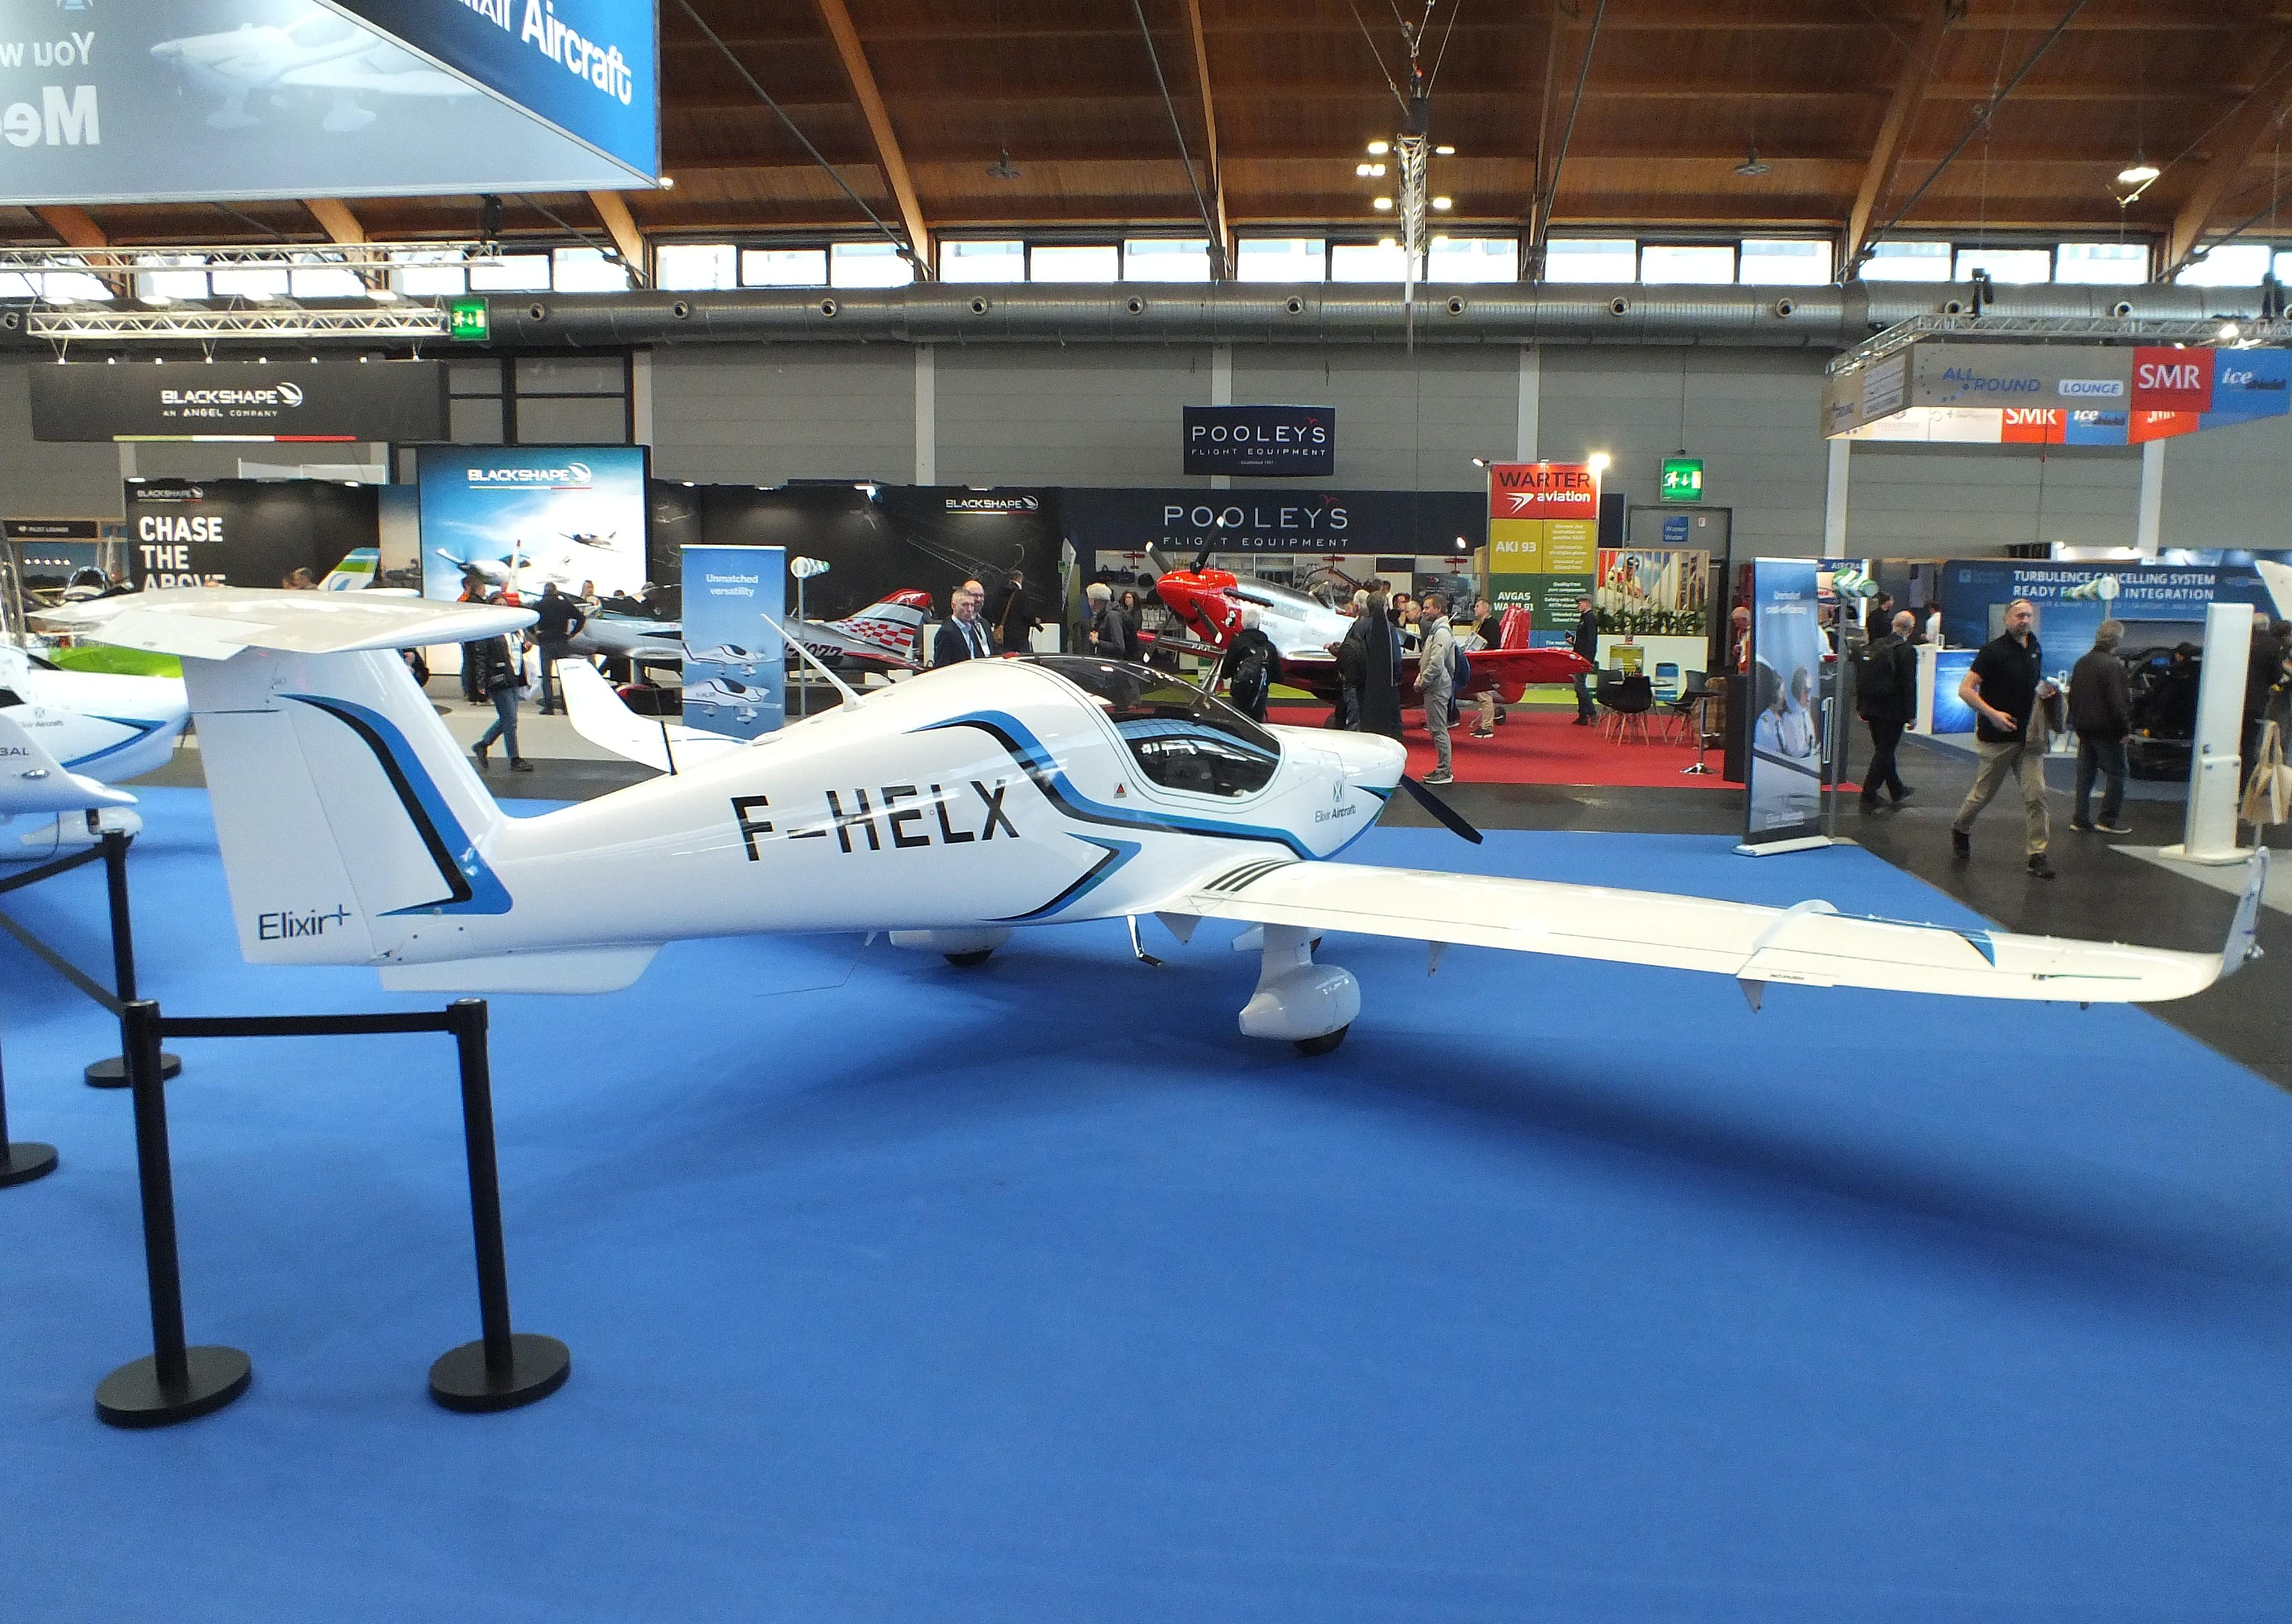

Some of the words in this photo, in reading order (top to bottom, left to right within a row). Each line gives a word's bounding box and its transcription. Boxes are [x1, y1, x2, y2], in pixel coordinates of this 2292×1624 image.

[521, 0, 632, 105] Aircraft
[2139, 364, 2201, 389] SMR
[2222, 368, 2253, 384] ice
[2064, 383, 2119, 394] LOUNGE
[162, 390, 278, 404] BLACKSHAPE
[183, 409, 224, 417] ANGEL
[1192, 426, 1326, 443] POOLEYS
[468, 469, 569, 481] BLACKSHAPE
[1500, 472, 1590, 488] WARTER
[1536, 490, 1590, 502] aviation
[946, 499, 1022, 509] BLACKSHAPE
[1164, 505, 1348, 529] POOLEYS
[139, 516, 224, 542] CHASE
[1163, 537, 1228, 546] FLIGT
[1242, 537, 1348, 547] EQUIPMENT
[1495, 541, 1519, 552] AKI
[1521, 542, 1537, 552] 93
[139, 545, 190, 569] THE
[144, 573, 226, 591] ABOV
[705, 574, 758, 583] Unmatched
[2014, 570, 2091, 582] TURBULENCE
[2170, 573, 2216, 584] SYSTEM
[710, 587, 755, 597] versatility
[1497, 591, 1531, 601] AVGAS
[2013, 586, 2056, 597] READY
[2125, 588, 2214, 601] INTEGRATION
[1524, 603, 1535, 612] 91
[1332, 804, 1356, 819] Aircraft
[730, 779, 1021, 862] F-HELX
